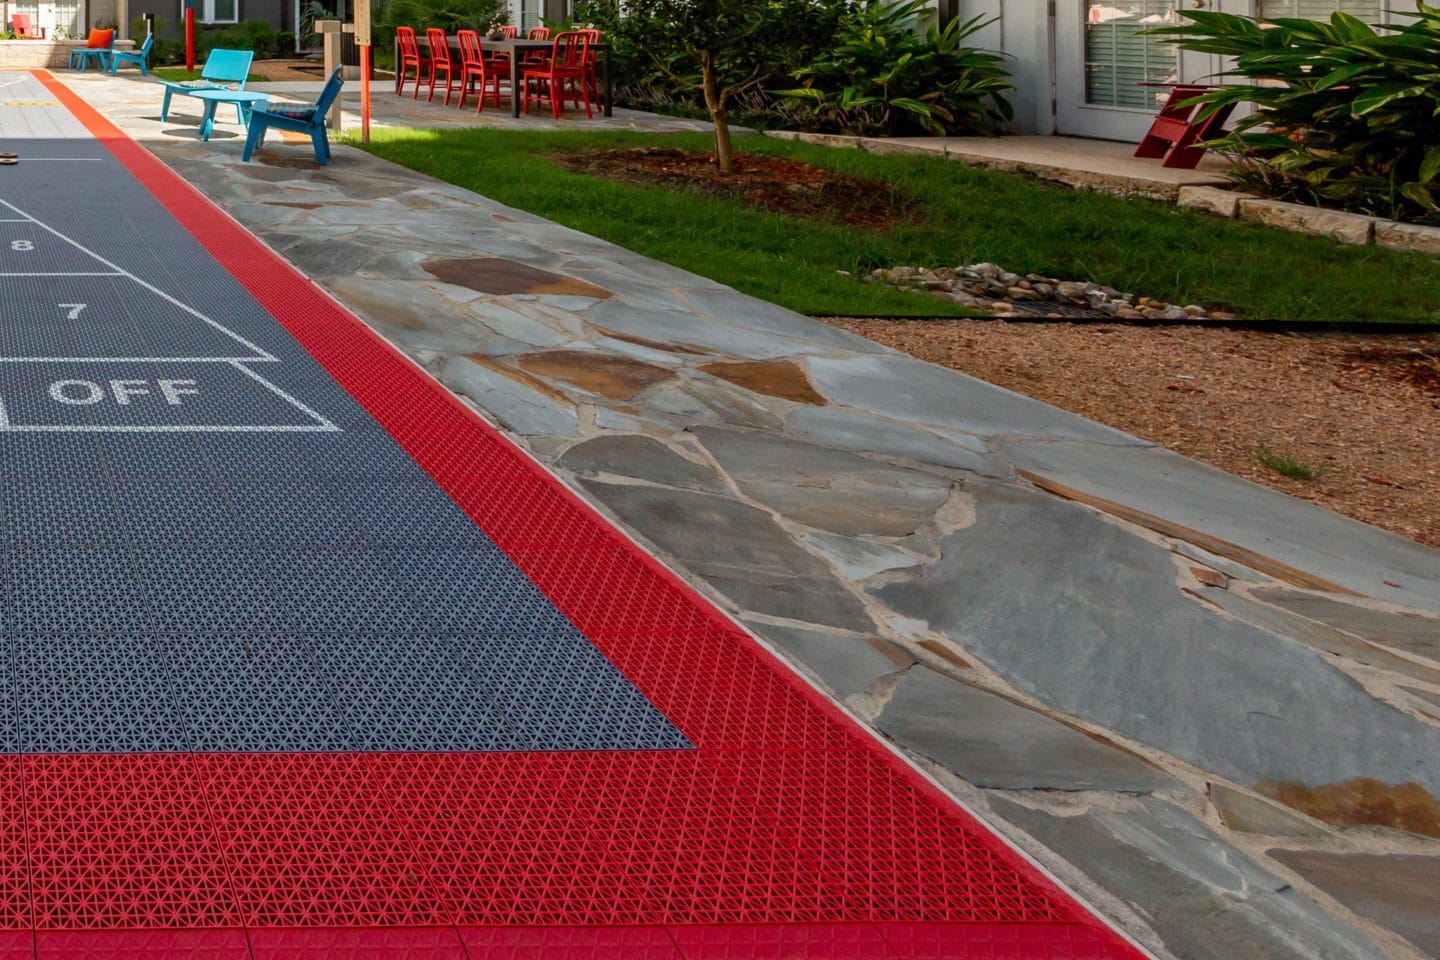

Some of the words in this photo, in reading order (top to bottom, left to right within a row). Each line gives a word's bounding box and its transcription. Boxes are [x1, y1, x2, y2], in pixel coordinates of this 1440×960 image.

[10, 240, 35, 251] 8
[58, 303, 87, 320] 7
[47, 378, 200, 406] OFF
